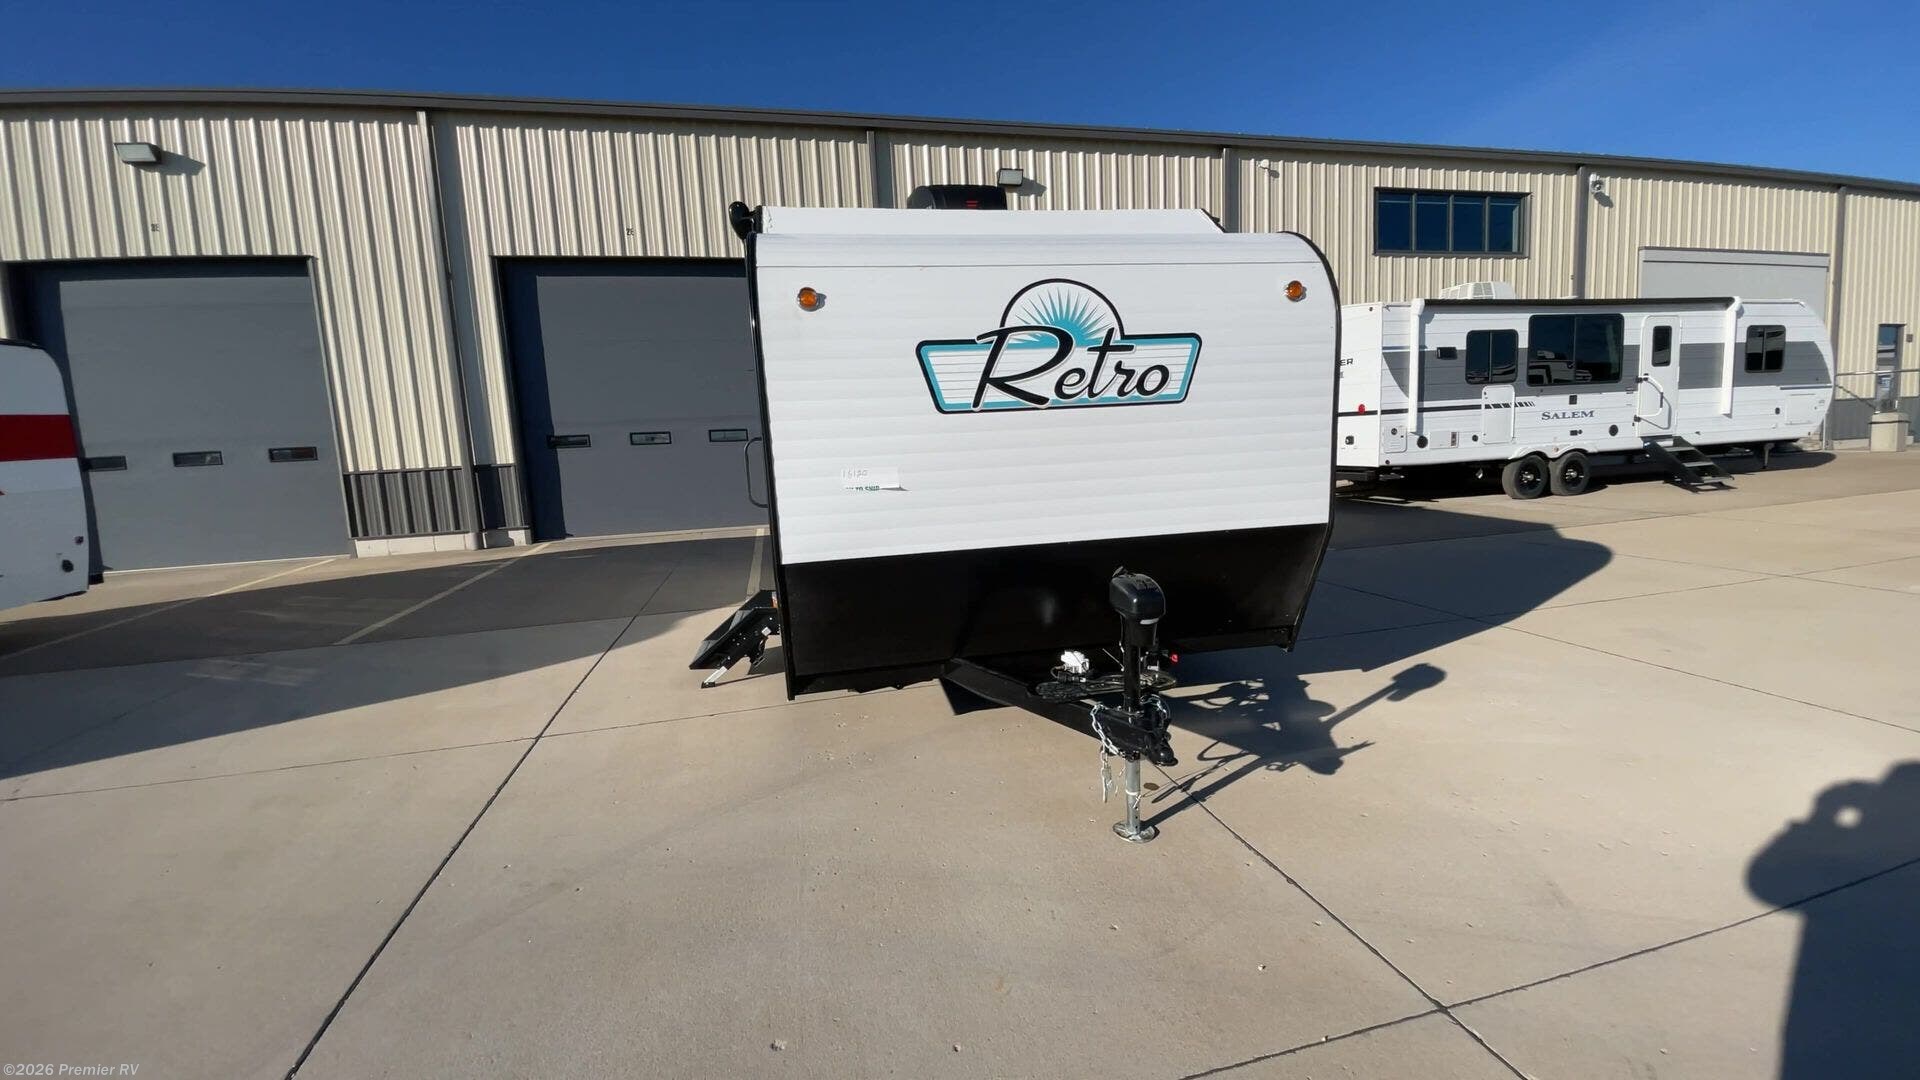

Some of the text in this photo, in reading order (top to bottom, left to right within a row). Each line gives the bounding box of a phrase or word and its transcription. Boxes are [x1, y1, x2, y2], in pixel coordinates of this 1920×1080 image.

[972, 325, 1170, 409] Retro
[1339, 358, 1353, 366] ER
[1541, 409, 1596, 421] SALEM
